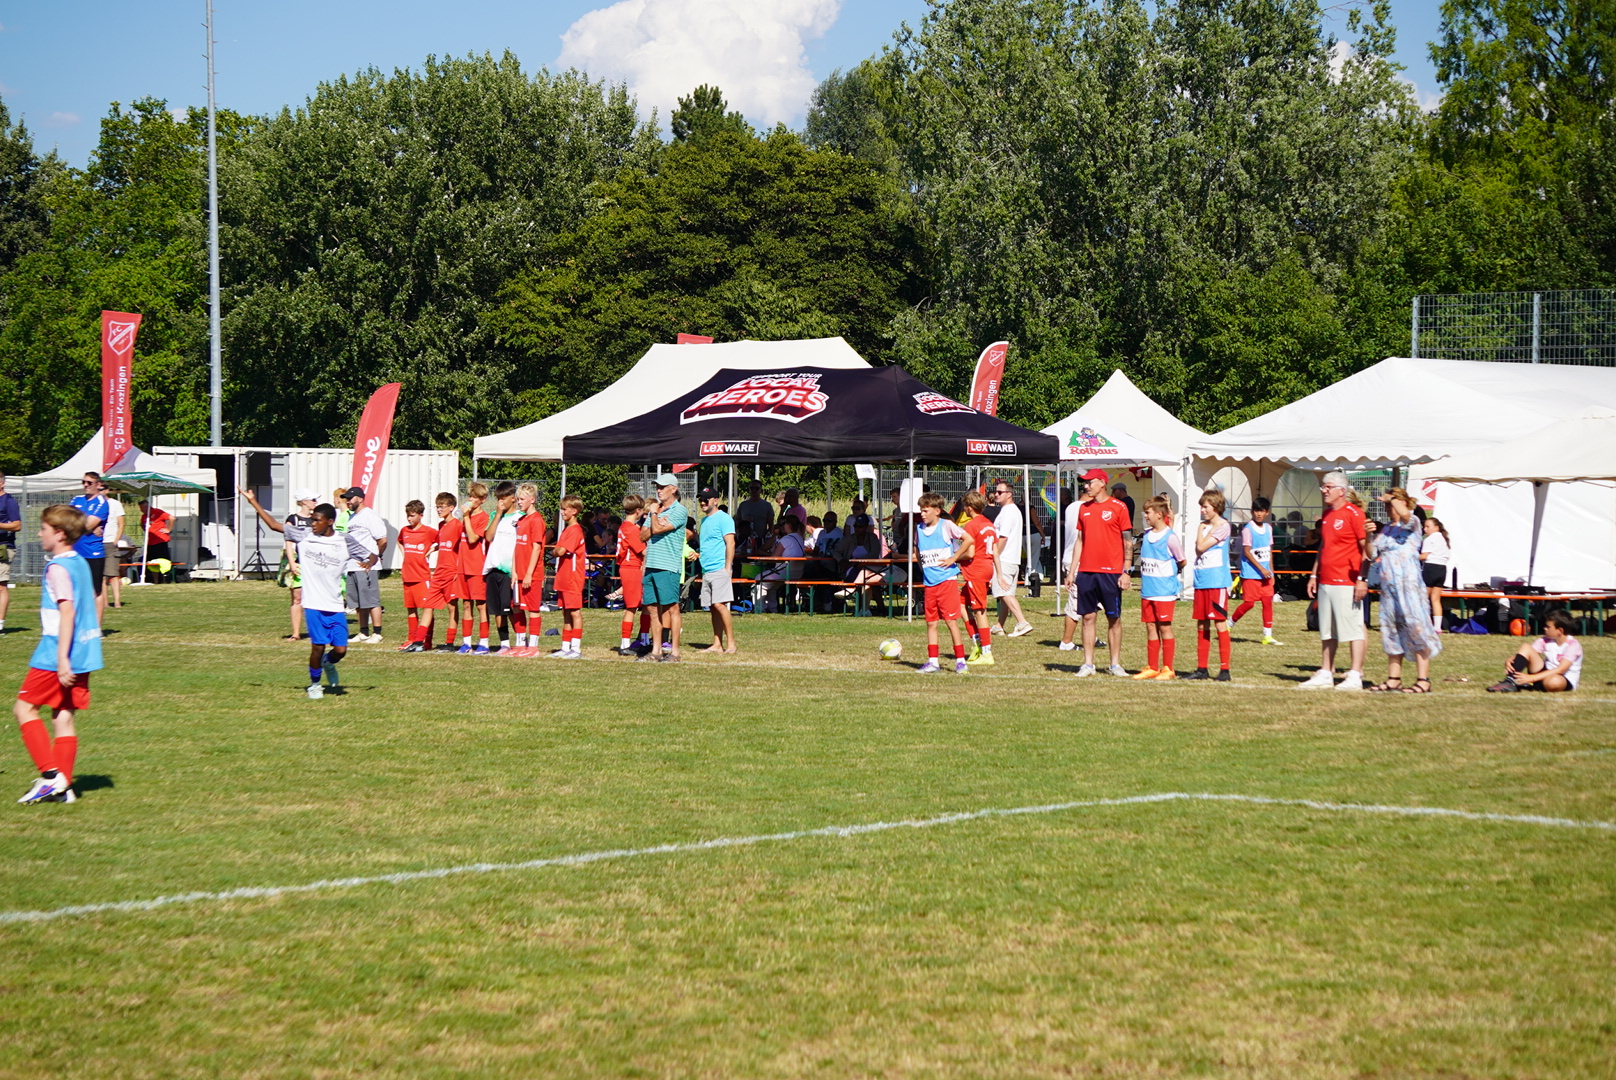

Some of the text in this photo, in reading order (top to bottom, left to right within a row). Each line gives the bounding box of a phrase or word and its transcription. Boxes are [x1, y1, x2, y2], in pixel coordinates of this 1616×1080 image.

[116, 366, 128, 414] Krozingen
[731, 377, 818, 390] LOCAL
[686, 387, 827, 412] HEROES
